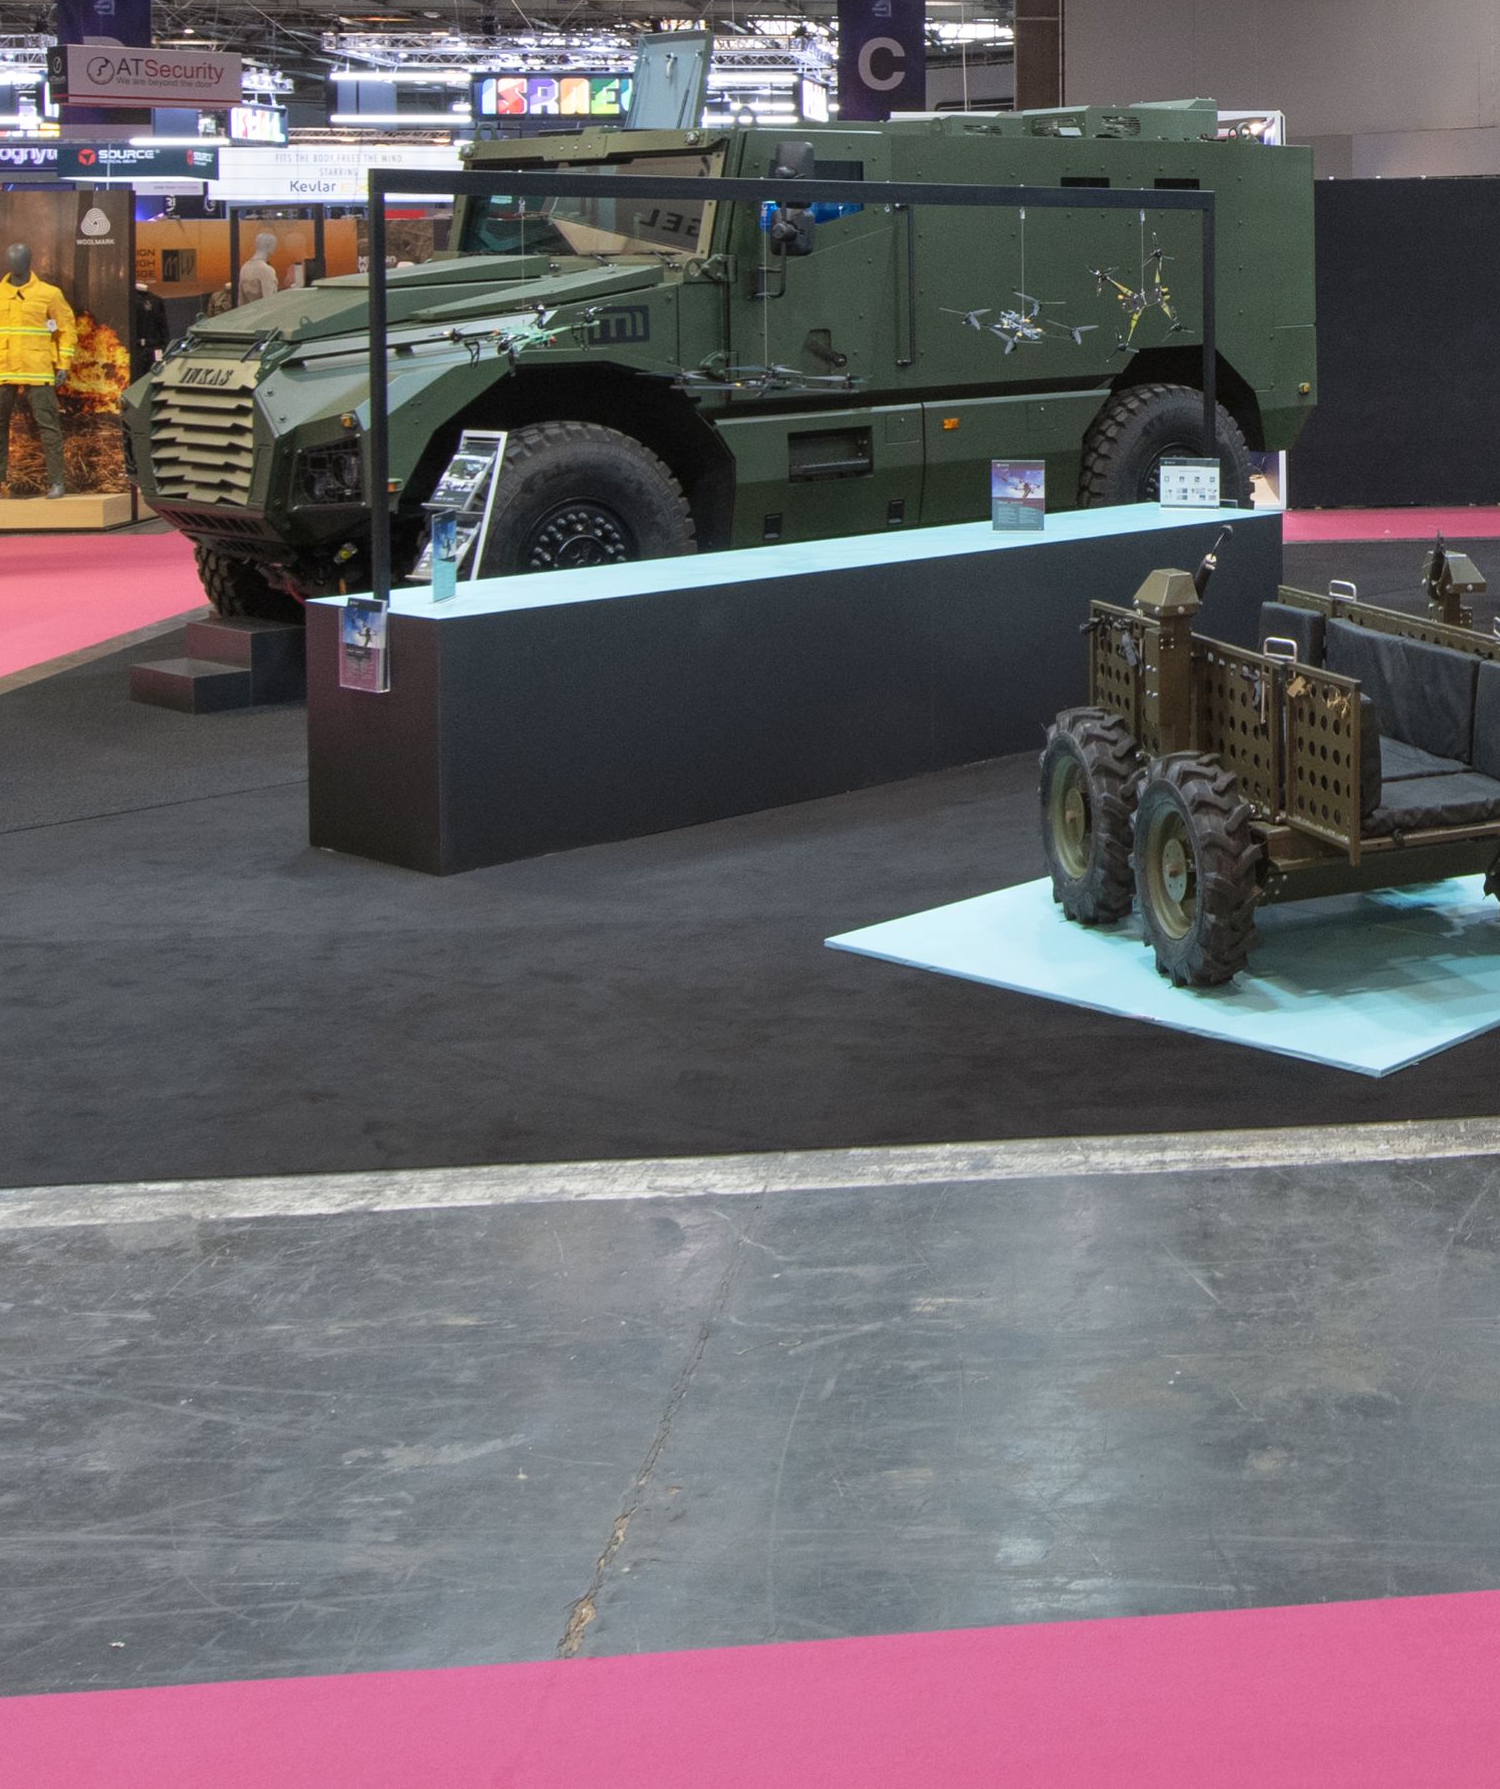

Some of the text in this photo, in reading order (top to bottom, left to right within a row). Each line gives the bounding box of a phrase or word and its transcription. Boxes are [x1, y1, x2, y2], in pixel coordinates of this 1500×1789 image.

[858, 37, 905, 91] C
[116, 58, 224, 84] ATSecurity
[116, 77, 131, 85] We
[148, 78, 179, 88] beyond
[296, 154, 309, 162] THE
[364, 154, 378, 162] THE
[320, 168, 359, 177] STARRING
[290, 181, 337, 192] Kevlar
[179, 367, 233, 386] INKAS
